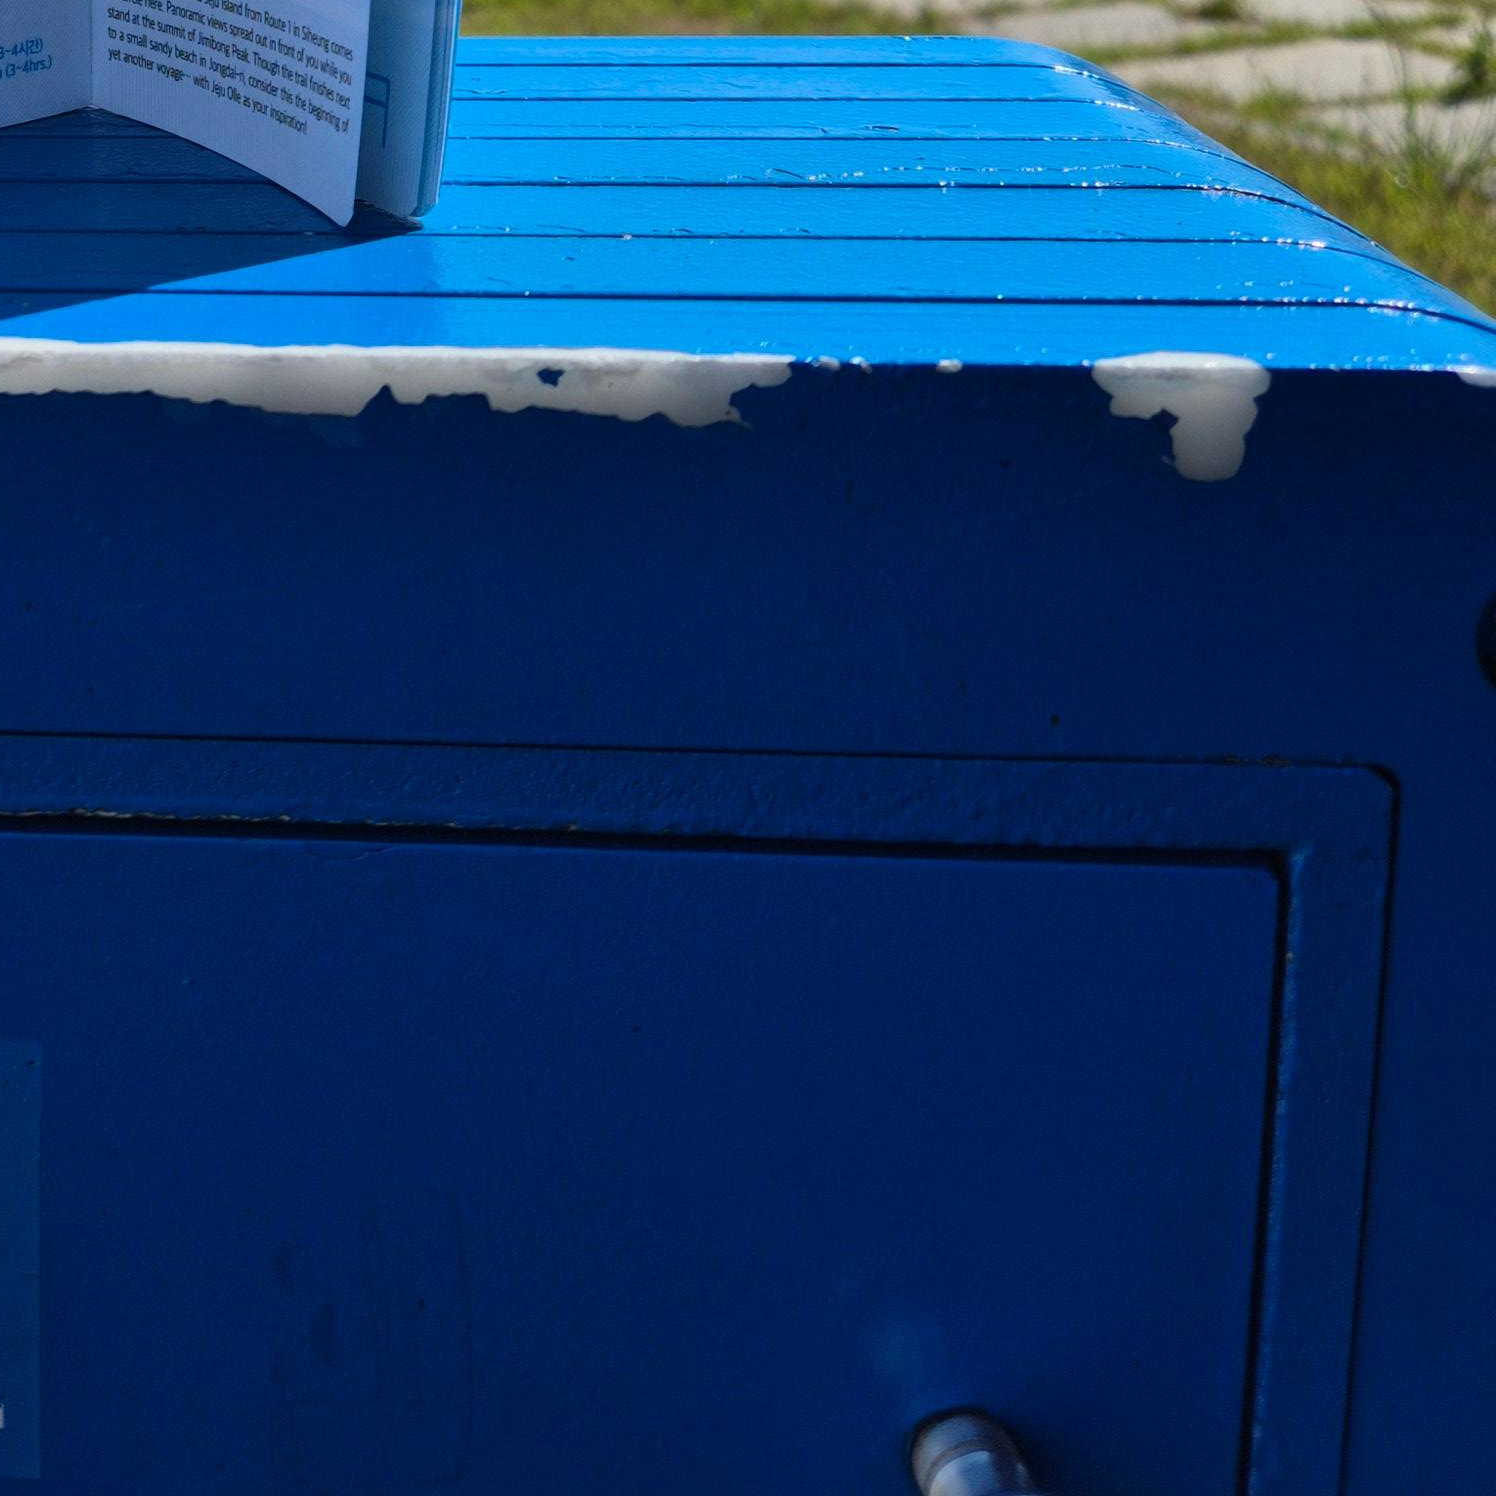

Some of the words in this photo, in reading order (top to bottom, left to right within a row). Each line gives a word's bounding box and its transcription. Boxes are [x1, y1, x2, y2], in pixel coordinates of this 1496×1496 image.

[5, 55, 52, 78] (3~4hrs.)
[107, 7, 130, 23] stand
[132, 13, 140, 26] at
[142, 15, 156, 30] the
[157, 21, 185, 40] summit
[188, 29, 196, 42] of
[197, 32, 230, 58] Jimibong
[252, 51, 280, 76] Though
[282, 64, 293, 82] the
[295, 71, 308, 88] trail
[309, 75, 334, 102] finishes
[336, 93, 350, 110] next
[167, 1, 205, 25] Panoramic
[207, 16, 228, 33] views
[229, 22, 254, 42] spread
[255, 33, 267, 47] out
[269, 38, 276, 51] in
[278, 39, 295, 59] front
[297, 48, 304, 62] of
[305, 54, 318, 70] you
[320, 59, 338, 79] while
[339, 69, 352, 86] you
[244, 3, 262, 23] from
[264, 11, 286, 32] Route
[293, 23, 300, 37] in
[302, 26, 330, 53] Siheung
[331, 42, 353, 61] comes
[108, 26, 116, 39] to
[127, 33, 147, 48] small
[149, 39, 173, 58] sandy
[175, 44, 197, 64] beach
[199, 56, 206, 68] in
[248, 76, 279, 96] consider
[281, 88, 293, 104] this
[295, 93, 307, 110] the
[308, 98, 340, 132] beginning
[108, 47, 120, 61] yet
[123, 52, 154, 71] another
[193, 74, 210, 91] with
[211, 80, 226, 98] Jeju
[226, 86, 241, 104] Olle
[242, 95, 251, 108] as
[252, 102, 269, 116] your
[270, 104, 307, 136] inspiration!
